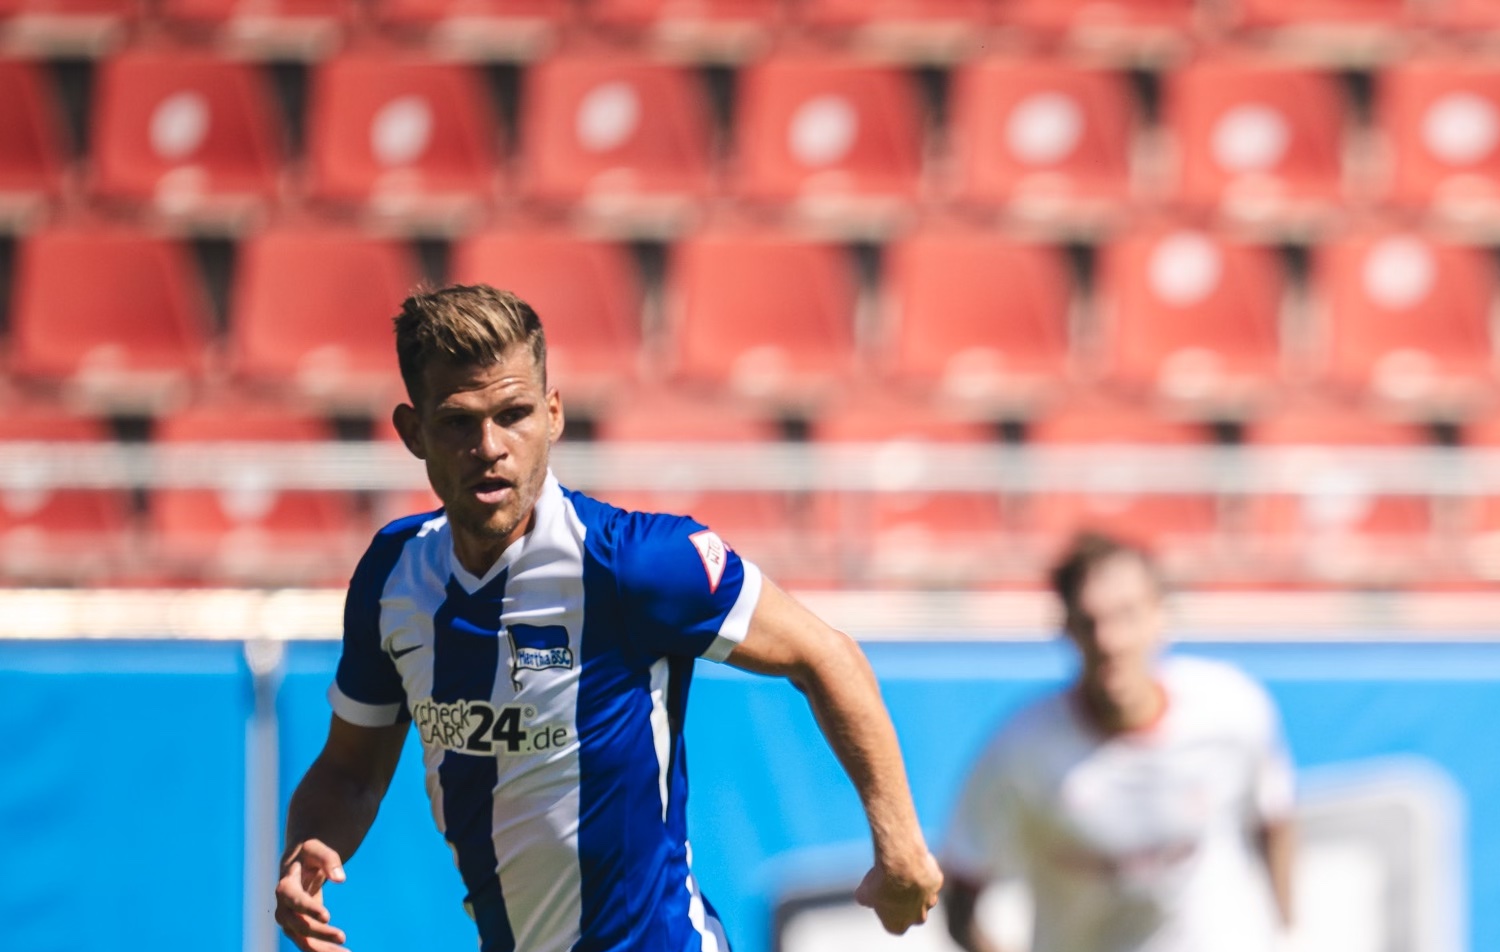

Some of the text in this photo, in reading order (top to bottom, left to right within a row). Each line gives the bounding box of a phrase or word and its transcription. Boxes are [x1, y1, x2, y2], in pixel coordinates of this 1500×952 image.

[518, 650, 571, 668] Hertha BSC
[420, 701, 470, 728] check
[420, 719, 465, 749] CARS
